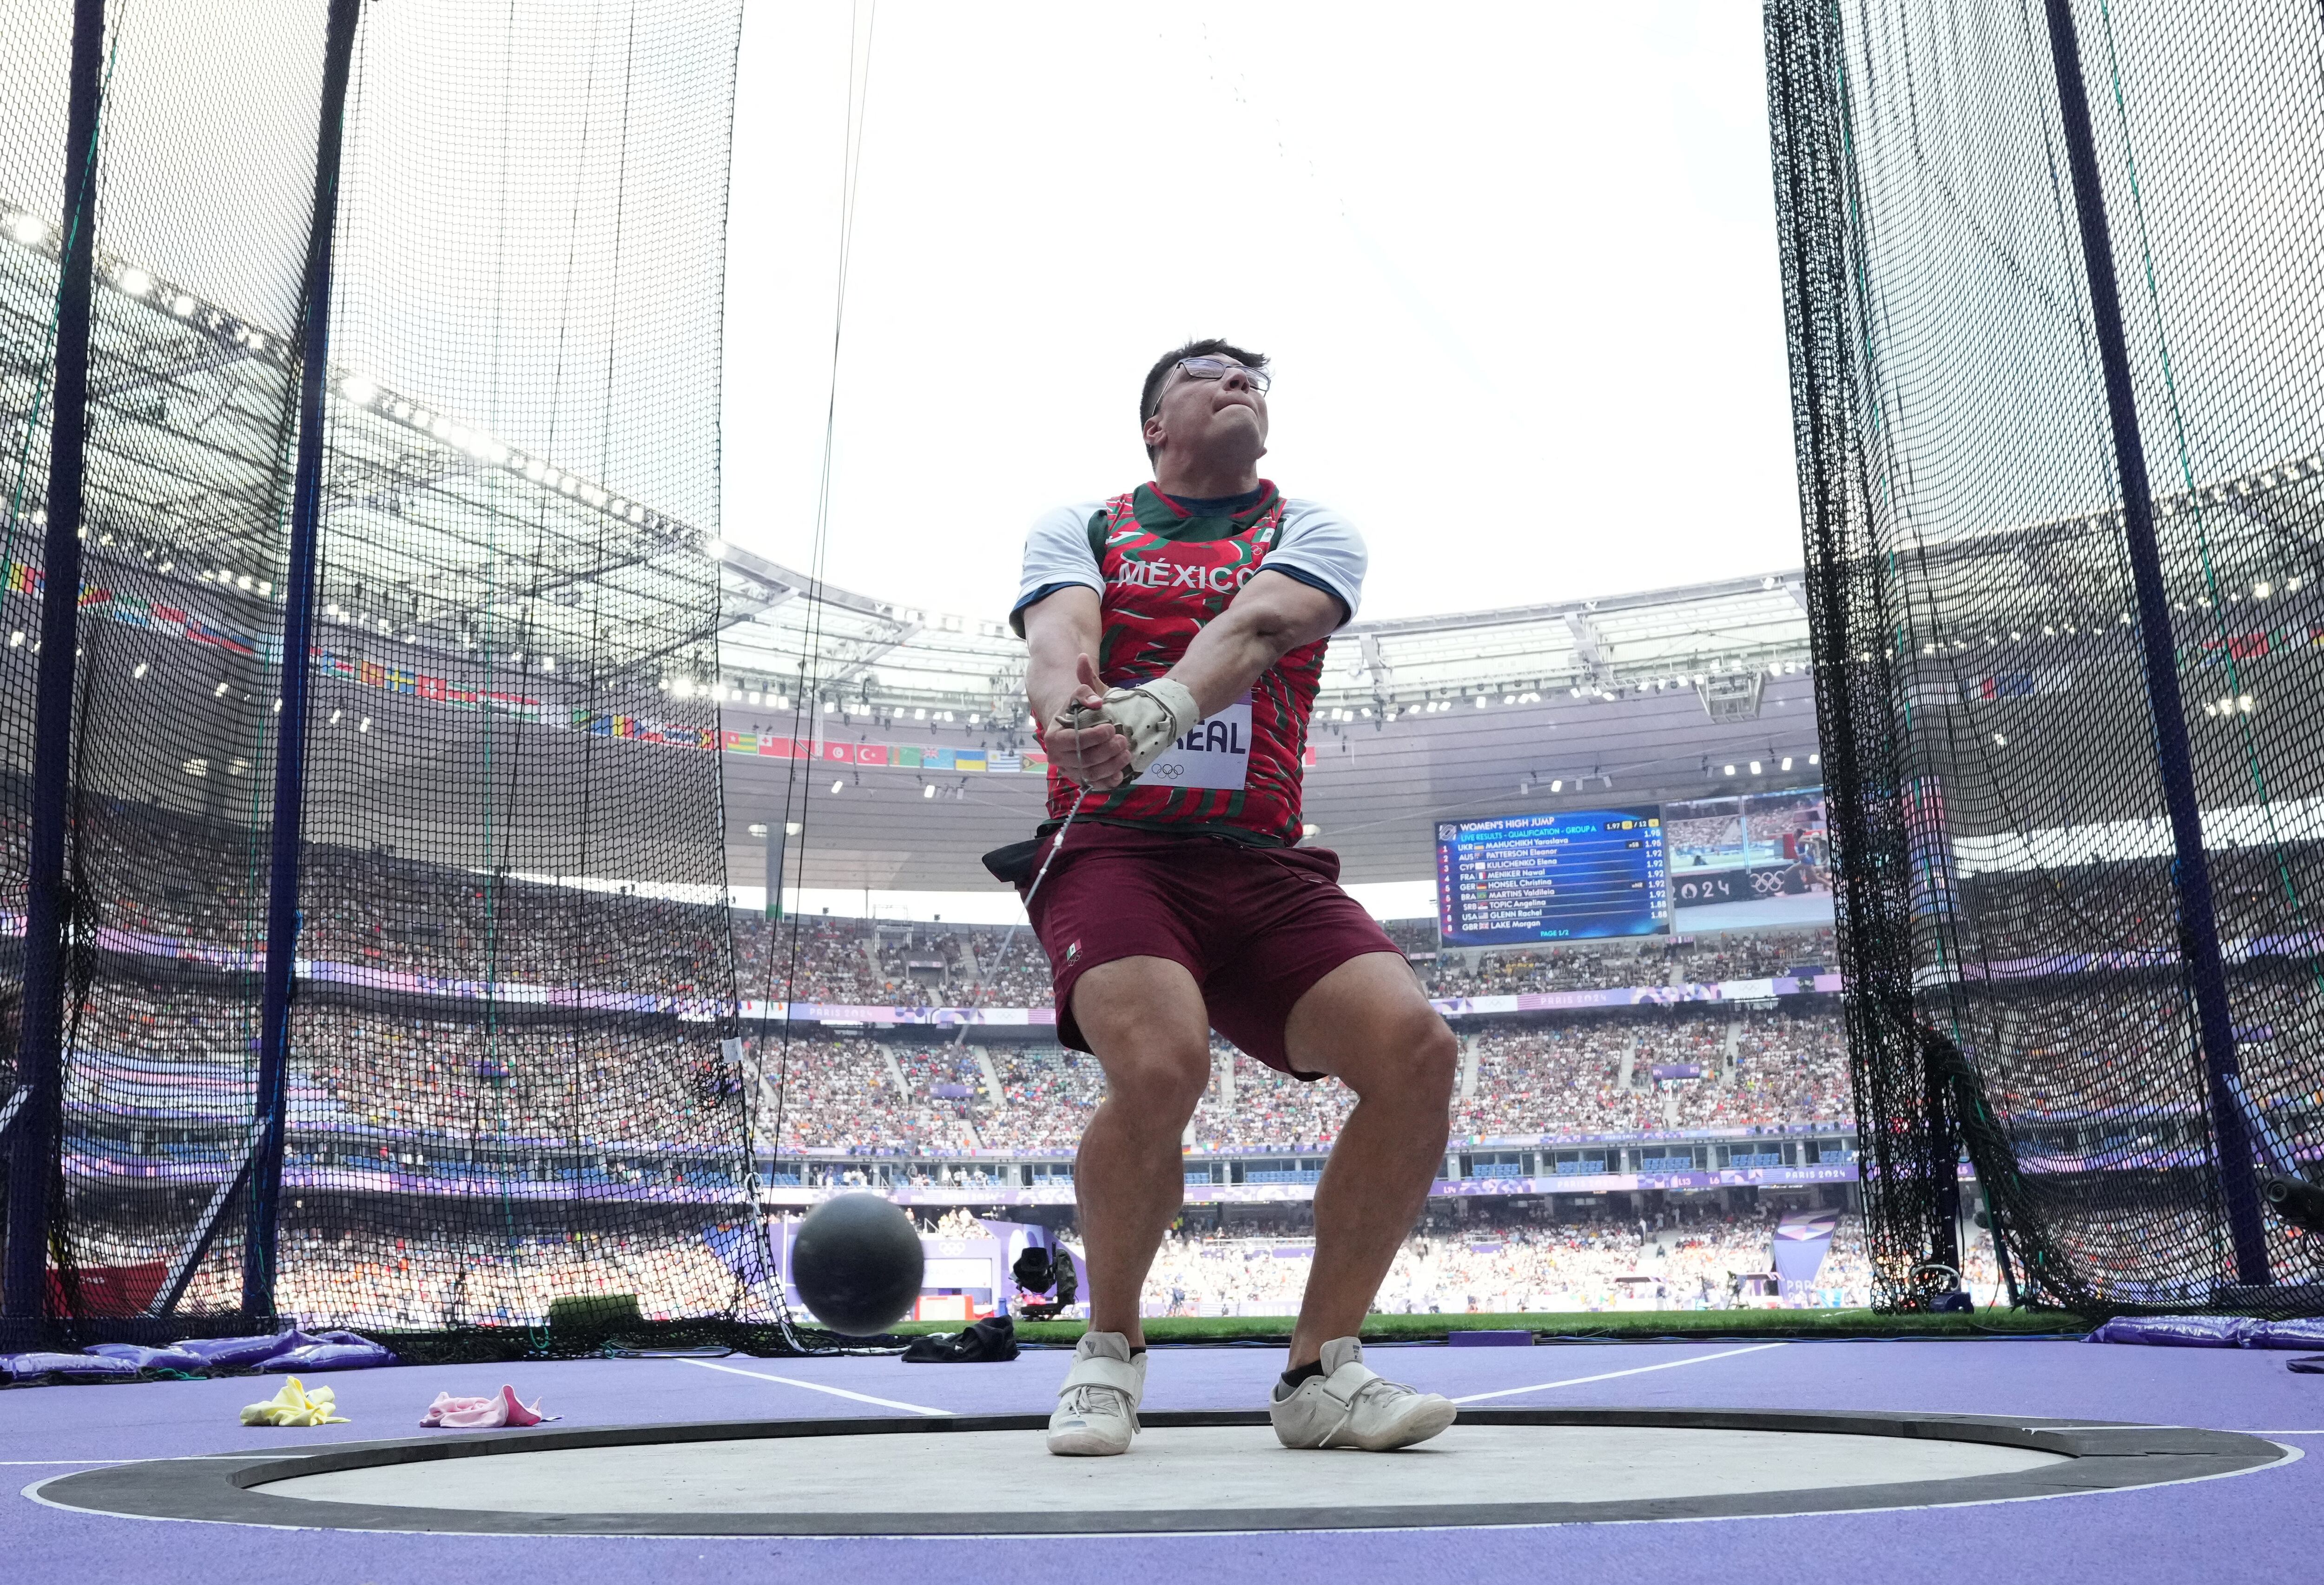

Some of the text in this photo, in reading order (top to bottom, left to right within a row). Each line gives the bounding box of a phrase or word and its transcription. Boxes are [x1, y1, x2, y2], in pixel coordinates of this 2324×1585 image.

[1460, 817, 1555, 831] WOMEN'S HIGH JUMP
[1476, 832, 1503, 841] RESULTS
[1508, 828, 1560, 838] QUALIFICATION
[1565, 826, 1591, 835] GROUP
[1458, 843, 1473, 851] UKR
[1486, 839, 1533, 849] MAHUCHIKH
[1534, 837, 1568, 845] Yaroslava
[1486, 849, 1528, 859] PATTERSON
[1487, 859, 1535, 869] KULICHENKO
[1487, 869, 1521, 879] MENIKER
[1488, 880, 1519, 889] HONSEL
[1519, 878, 1552, 887] Christina
[1489, 889, 1522, 898] MARTINS
[1649, 880, 1664, 888] 1.92
[1513, 899, 1546, 909] Angelina
[1650, 890, 1666, 898] 1.92
[1490, 911, 1516, 919] GLENN
[1491, 921, 1510, 929] LAKE
[1512, 920, 1541, 929] Morgan
[1541, 994, 1606, 1004] PARIS 2024
[810, 1008, 841, 1017] PARIS
[1818, 1170, 1845, 1178] 2024
